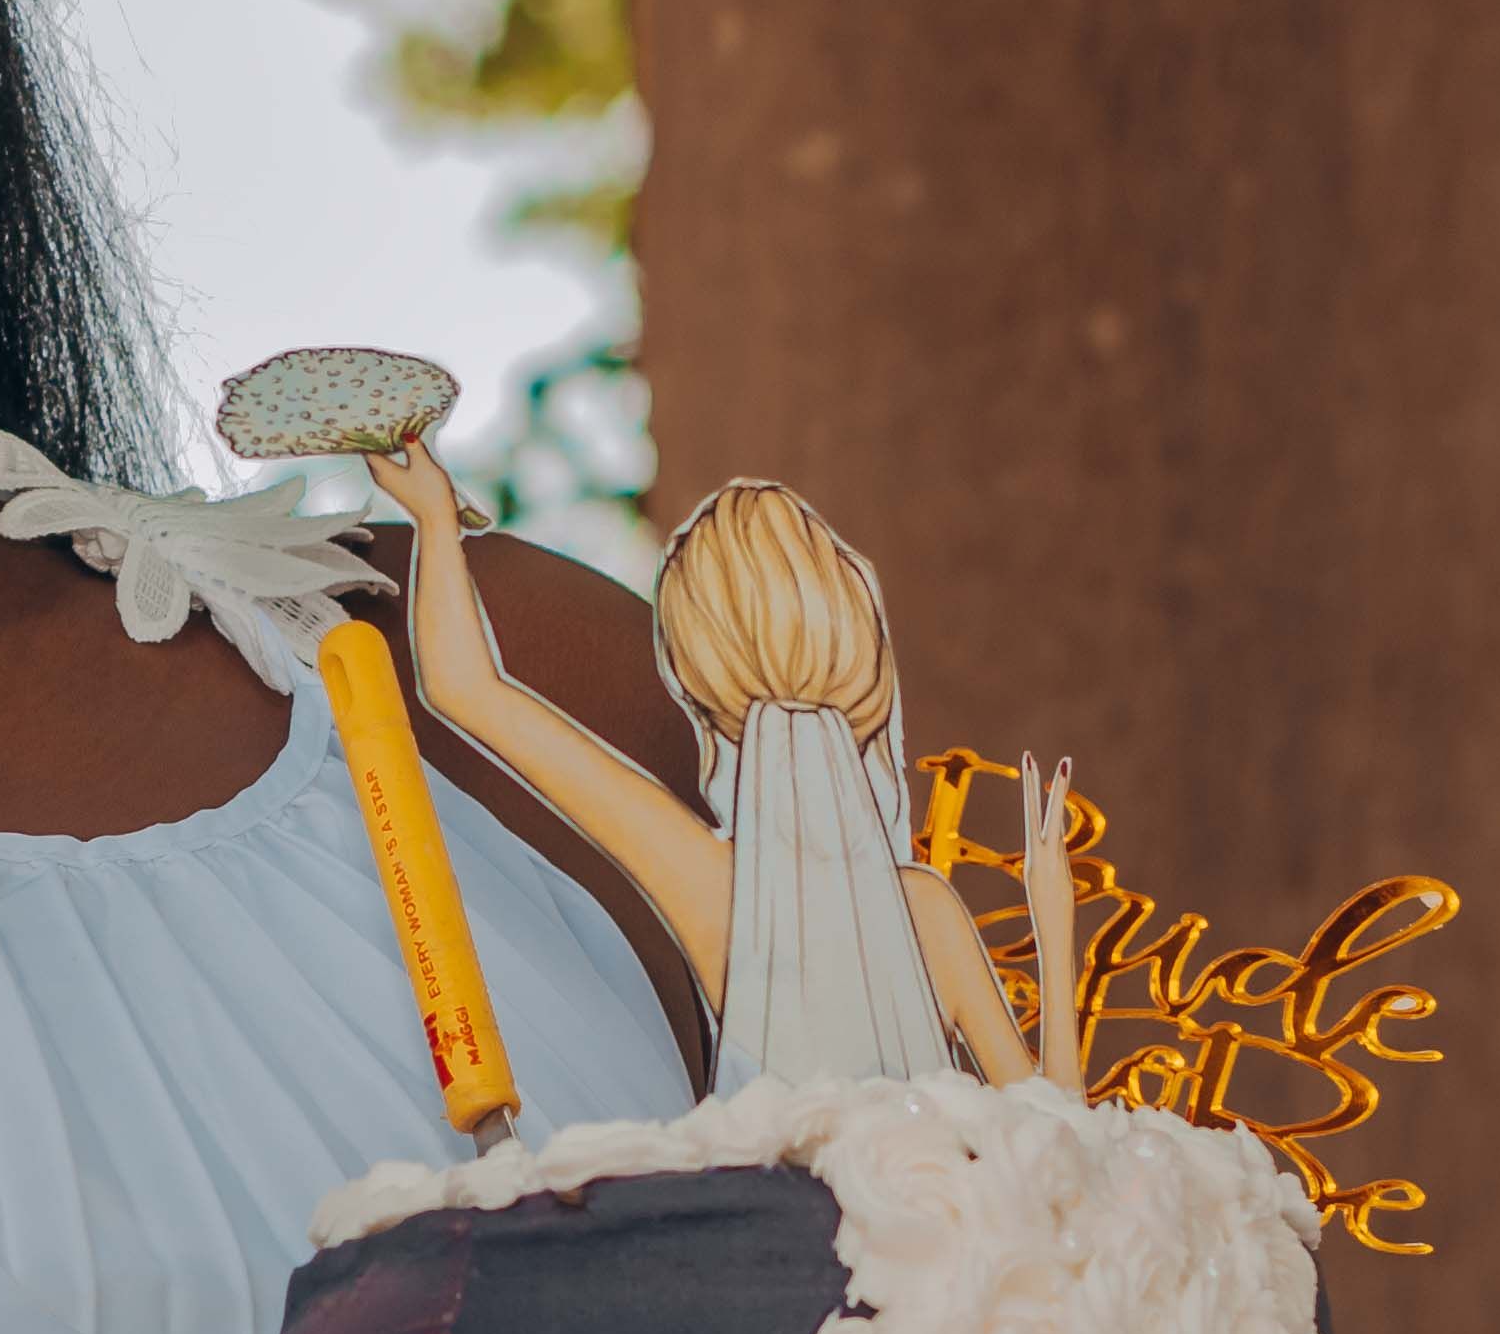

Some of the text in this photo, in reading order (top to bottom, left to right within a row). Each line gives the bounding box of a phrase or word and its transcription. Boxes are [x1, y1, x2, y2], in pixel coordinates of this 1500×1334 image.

[365, 767, 388, 817] STAR
[380, 819, 393, 833] A
[392, 862, 421, 935] WOMAN
[413, 939, 441, 999] EVERY
[454, 1006, 483, 1066] MAGGI
